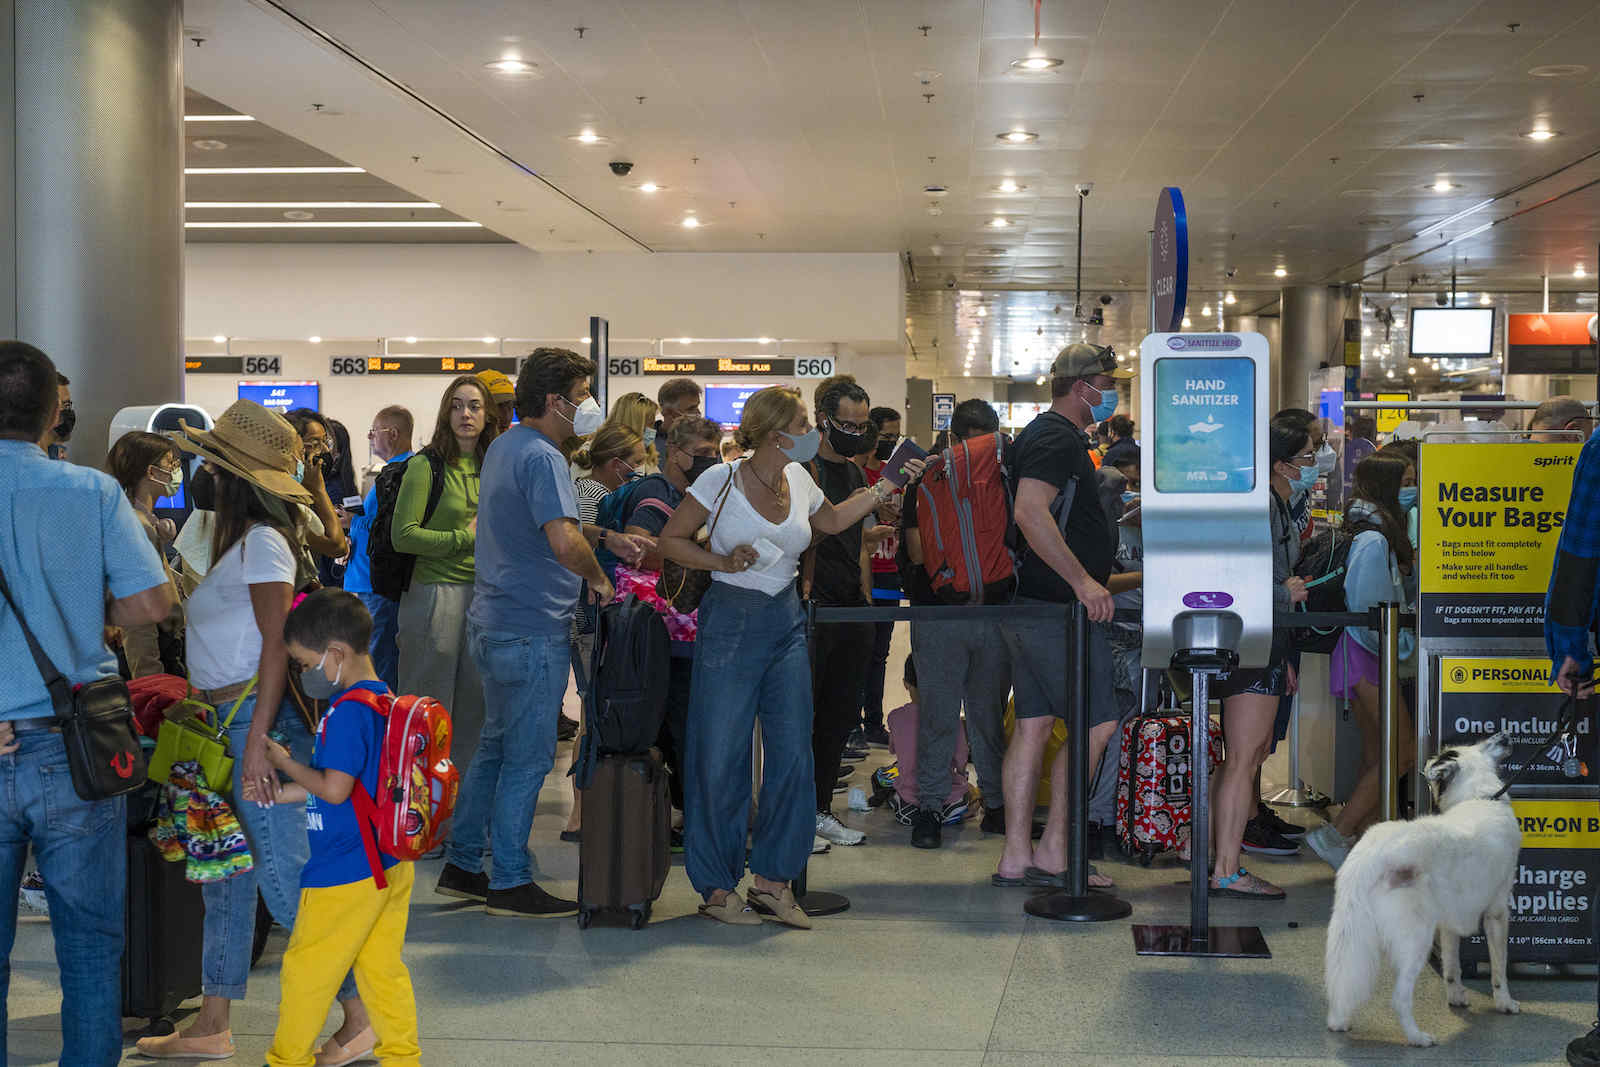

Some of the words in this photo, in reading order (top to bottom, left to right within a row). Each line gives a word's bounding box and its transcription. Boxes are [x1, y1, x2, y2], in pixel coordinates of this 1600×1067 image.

[246, 357, 280, 374] 564
[331, 358, 366, 374] 563
[609, 359, 640, 375] 561
[797, 359, 832, 376] 560
[1185, 379, 1225, 390] HAND
[1171, 394, 1239, 406] SANITIZER
[1533, 455, 1575, 467] spirit
[1438, 482, 1544, 502] Measure
[1437, 507, 1496, 527] Your
[1504, 507, 1564, 533] Bags
[1442, 540, 1461, 549] Bags
[1486, 540, 1495, 548] fit
[1497, 540, 1541, 549] completely
[1442, 563, 1463, 571] Make
[1485, 563, 1494, 571] all
[1496, 563, 1528, 571] handles
[1442, 572, 1458, 580] and
[1460, 572, 1488, 580] wheels
[1490, 572, 1499, 580] fit
[1435, 606, 1445, 614] IF
[1445, 606, 1453, 614] IT
[1455, 606, 1490, 614] DOESN'T
[1492, 606, 1506, 615] FIT,
[1508, 606, 1524, 614] PAY
[1525, 606, 1536, 614] AT
[1536, 606, 1543, 614] A
[1444, 617, 1460, 625] Bags
[1492, 617, 1524, 625] expensive
[1472, 669, 1553, 681] PERSONAL
[1455, 717, 1495, 734] One
[1501, 717, 1590, 734] Includ
[1513, 865, 1587, 889] harge
[1509, 936, 1515, 944] X
[1557, 937, 1563, 945] X
[1586, 937, 1593, 945] X
